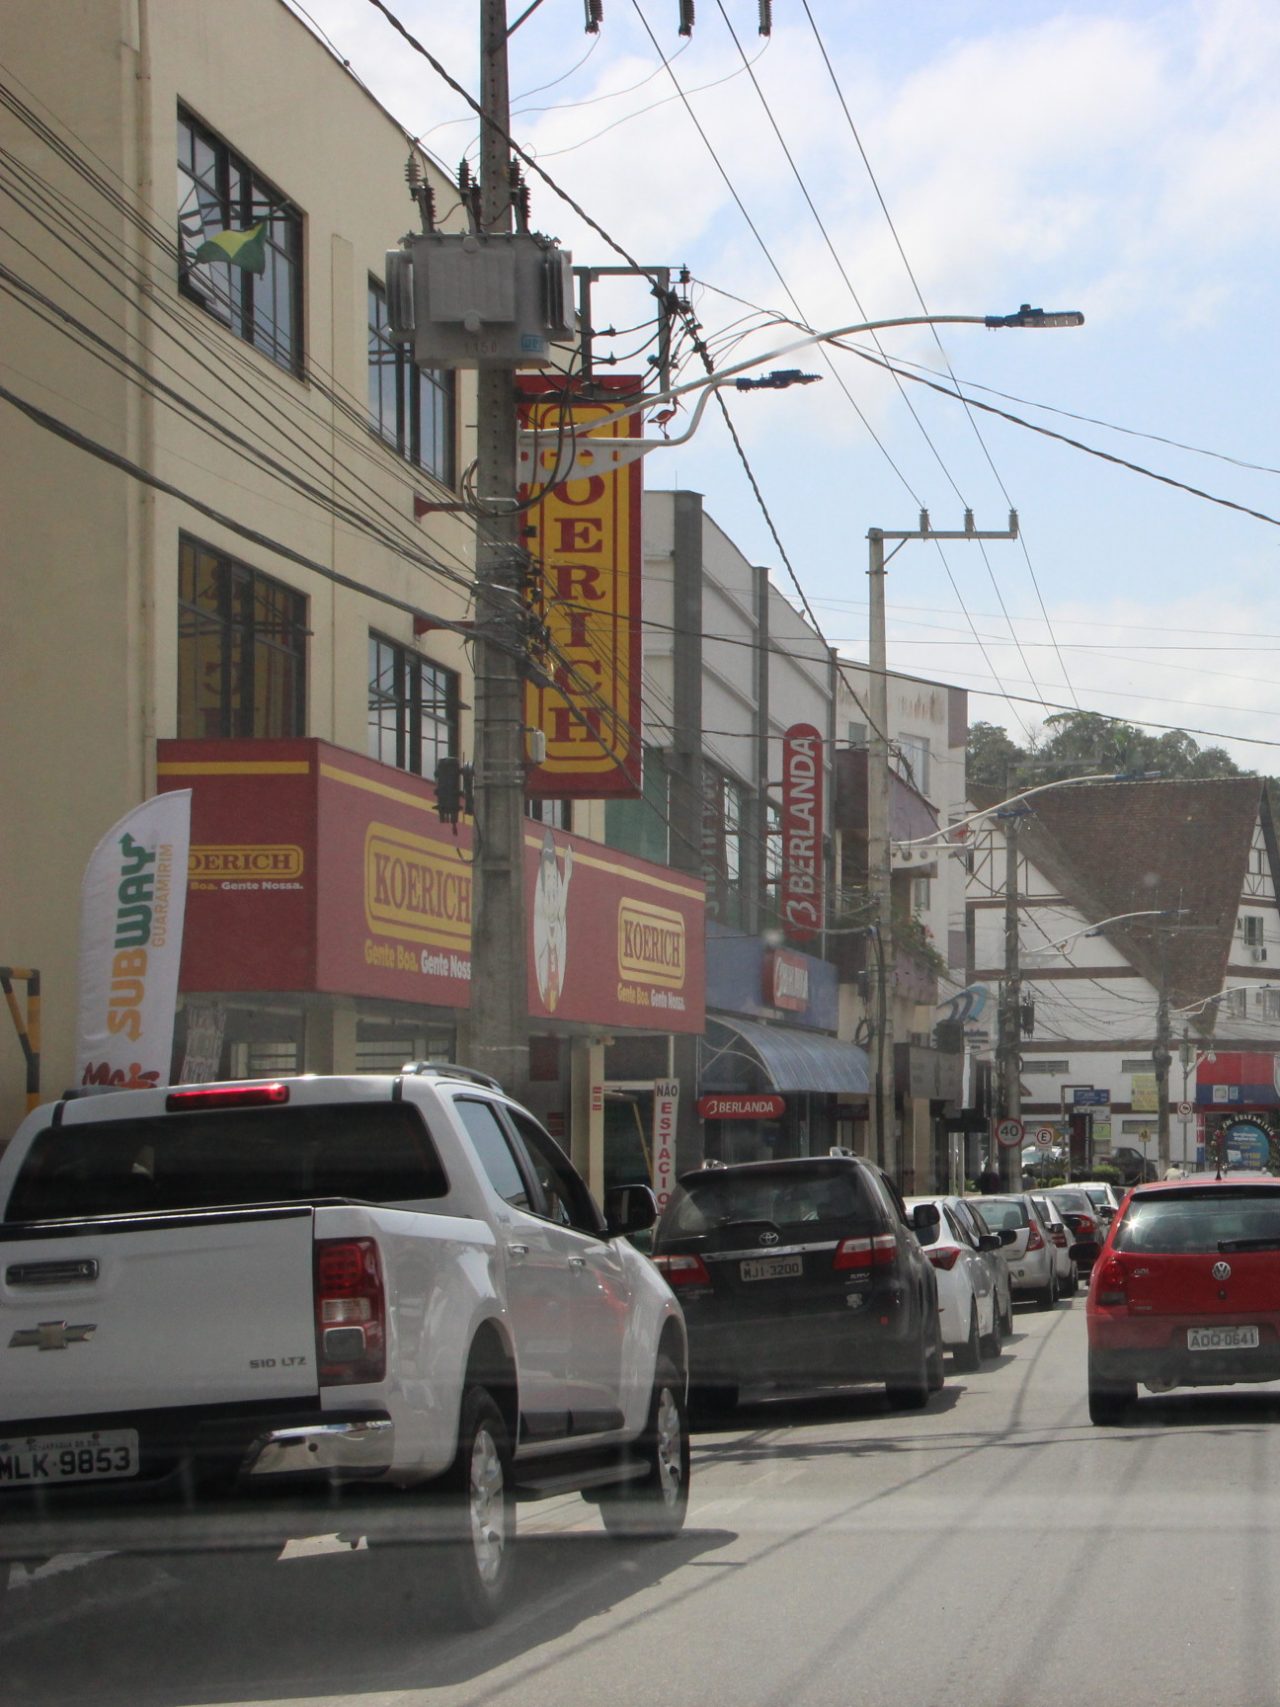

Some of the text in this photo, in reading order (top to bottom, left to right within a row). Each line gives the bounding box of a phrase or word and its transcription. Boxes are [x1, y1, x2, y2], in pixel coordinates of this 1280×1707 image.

[789, 735, 815, 895] BERLANDA
[188, 853, 293, 871] OERICH
[152, 844, 173, 948] GUARAMIRIM
[221, 881, 259, 890] Gente
[262, 881, 304, 890] Nossa.
[374, 853, 471, 922] KOERICH
[107, 832, 156, 1042] SUBWAY
[624, 919, 681, 968] KOERICH
[364, 940, 471, 980] Gente Boa. Gente Noss
[656, 1082, 678, 1097] NÃO
[719, 1100, 774, 1113] BERLANDA
[1001, 1125, 1018, 1137] 40
[657, 1102, 673, 1215] ESTACIO
[282, 1356, 306, 1367] LTZ
